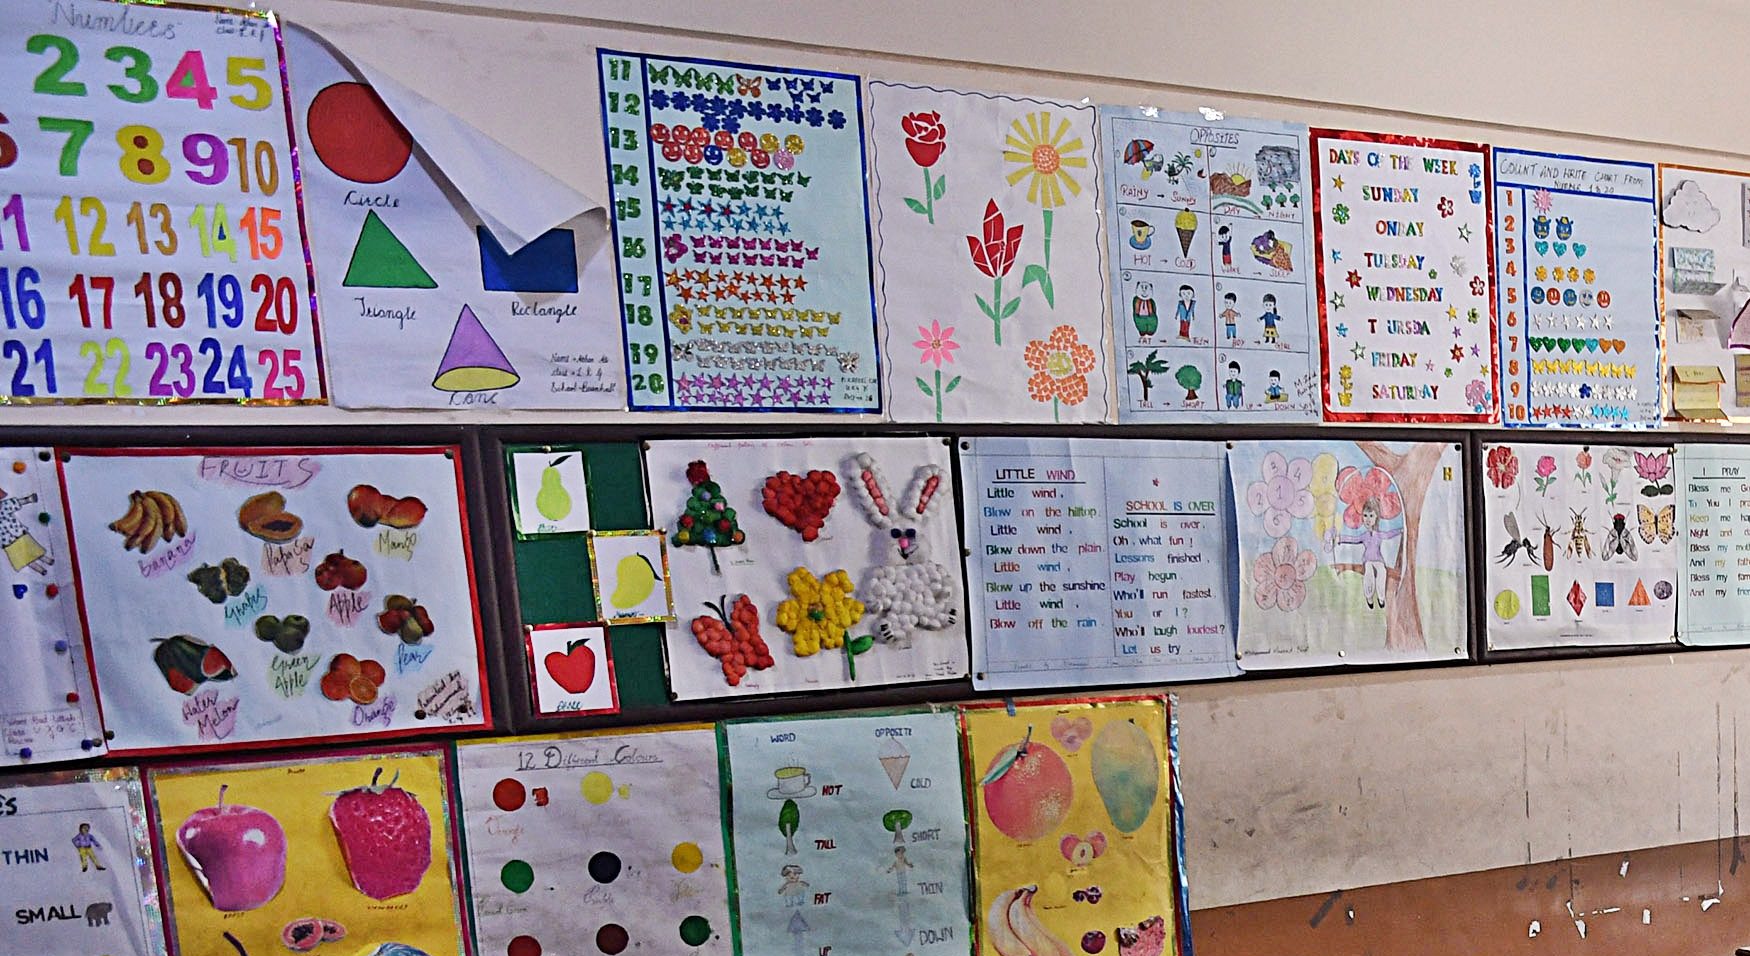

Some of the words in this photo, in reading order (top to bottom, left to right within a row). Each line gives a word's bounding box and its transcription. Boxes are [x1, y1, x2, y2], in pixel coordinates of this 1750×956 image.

[26, 33, 87, 96] 2
[104, 45, 159, 104] 3
[165, 50, 217, 109] 4
[226, 57, 273, 111] 5
[608, 58, 631, 81] 11
[608, 92, 640, 116] 12
[610, 127, 639, 150] 13
[38, 116, 94, 176] 7
[115, 124, 171, 185] 8
[182, 133, 229, 185] 9
[227, 137, 279, 196] 10
[1422, 156, 1458, 175] WEEK
[1540, 166, 1559, 179] AND
[612, 164, 639, 186] 14
[343, 190, 400, 208] Circle
[1505, 190, 1513, 206] 1
[615, 198, 641, 221] 15
[54, 196, 116, 256] 12
[126, 201, 179, 255] 13
[188, 202, 237, 263] 14
[239, 206, 283, 261] 15
[1504, 216, 1515, 232] 2
[622, 236, 646, 259] 16
[1505, 238, 1516, 253] 3
[1505, 260, 1517, 276] 4
[623, 272, 652, 296] 17
[0, 266, 46, 329] 16
[68, 275, 115, 329] 17
[134, 272, 184, 328] 18
[198, 272, 244, 329] 19
[250, 273, 297, 335] 20
[1507, 288, 1516, 303] 5
[511, 300, 578, 320] Rectangle
[625, 304, 653, 326] 18
[1507, 312, 1517, 327] 6
[1508, 336, 1518, 352] 7
[629, 343, 659, 365] 19
[2, 338, 57, 395] 21
[79, 340, 132, 397] 22
[145, 341, 196, 397] 23
[199, 338, 253, 398] 24
[257, 350, 305, 400] 25
[1509, 360, 1518, 375] 8
[631, 373, 665, 395] 20
[1510, 382, 1520, 397] 9
[1508, 403, 1525, 420] 10
[201, 458, 314, 488] FRUITS
[996, 469, 1035, 480] LITTLE
[1046, 470, 1075, 480] WIND
[984, 507, 1011, 517] Blow
[1022, 509, 1034, 517] on
[1045, 507, 1061, 517] the
[1126, 501, 1167, 511] SCHOOL
[1173, 501, 1182, 511] IS
[1188, 501, 1215, 512] OVER
[1113, 518, 1147, 528] School
[1160, 520, 1167, 528] is
[986, 545, 1012, 555] Blow
[1018, 544, 1045, 554] down
[1052, 543, 1068, 554] the
[986, 583, 1013, 592] Blow
[1019, 583, 1032, 593] up
[1040, 582, 1056, 592] the
[1063, 582, 1105, 591] sunshine
[990, 619, 1016, 629] Blow
[1028, 618, 1043, 628] off
[1052, 618, 1068, 628] the
[1077, 618, 1097, 627] rain
[1153, 625, 1177, 638] laugh
[770, 732, 796, 743] WORD
[2, 848, 49, 865] THIN
[15, 904, 82, 925] SMALL
[919, 927, 954, 946] DOWN
